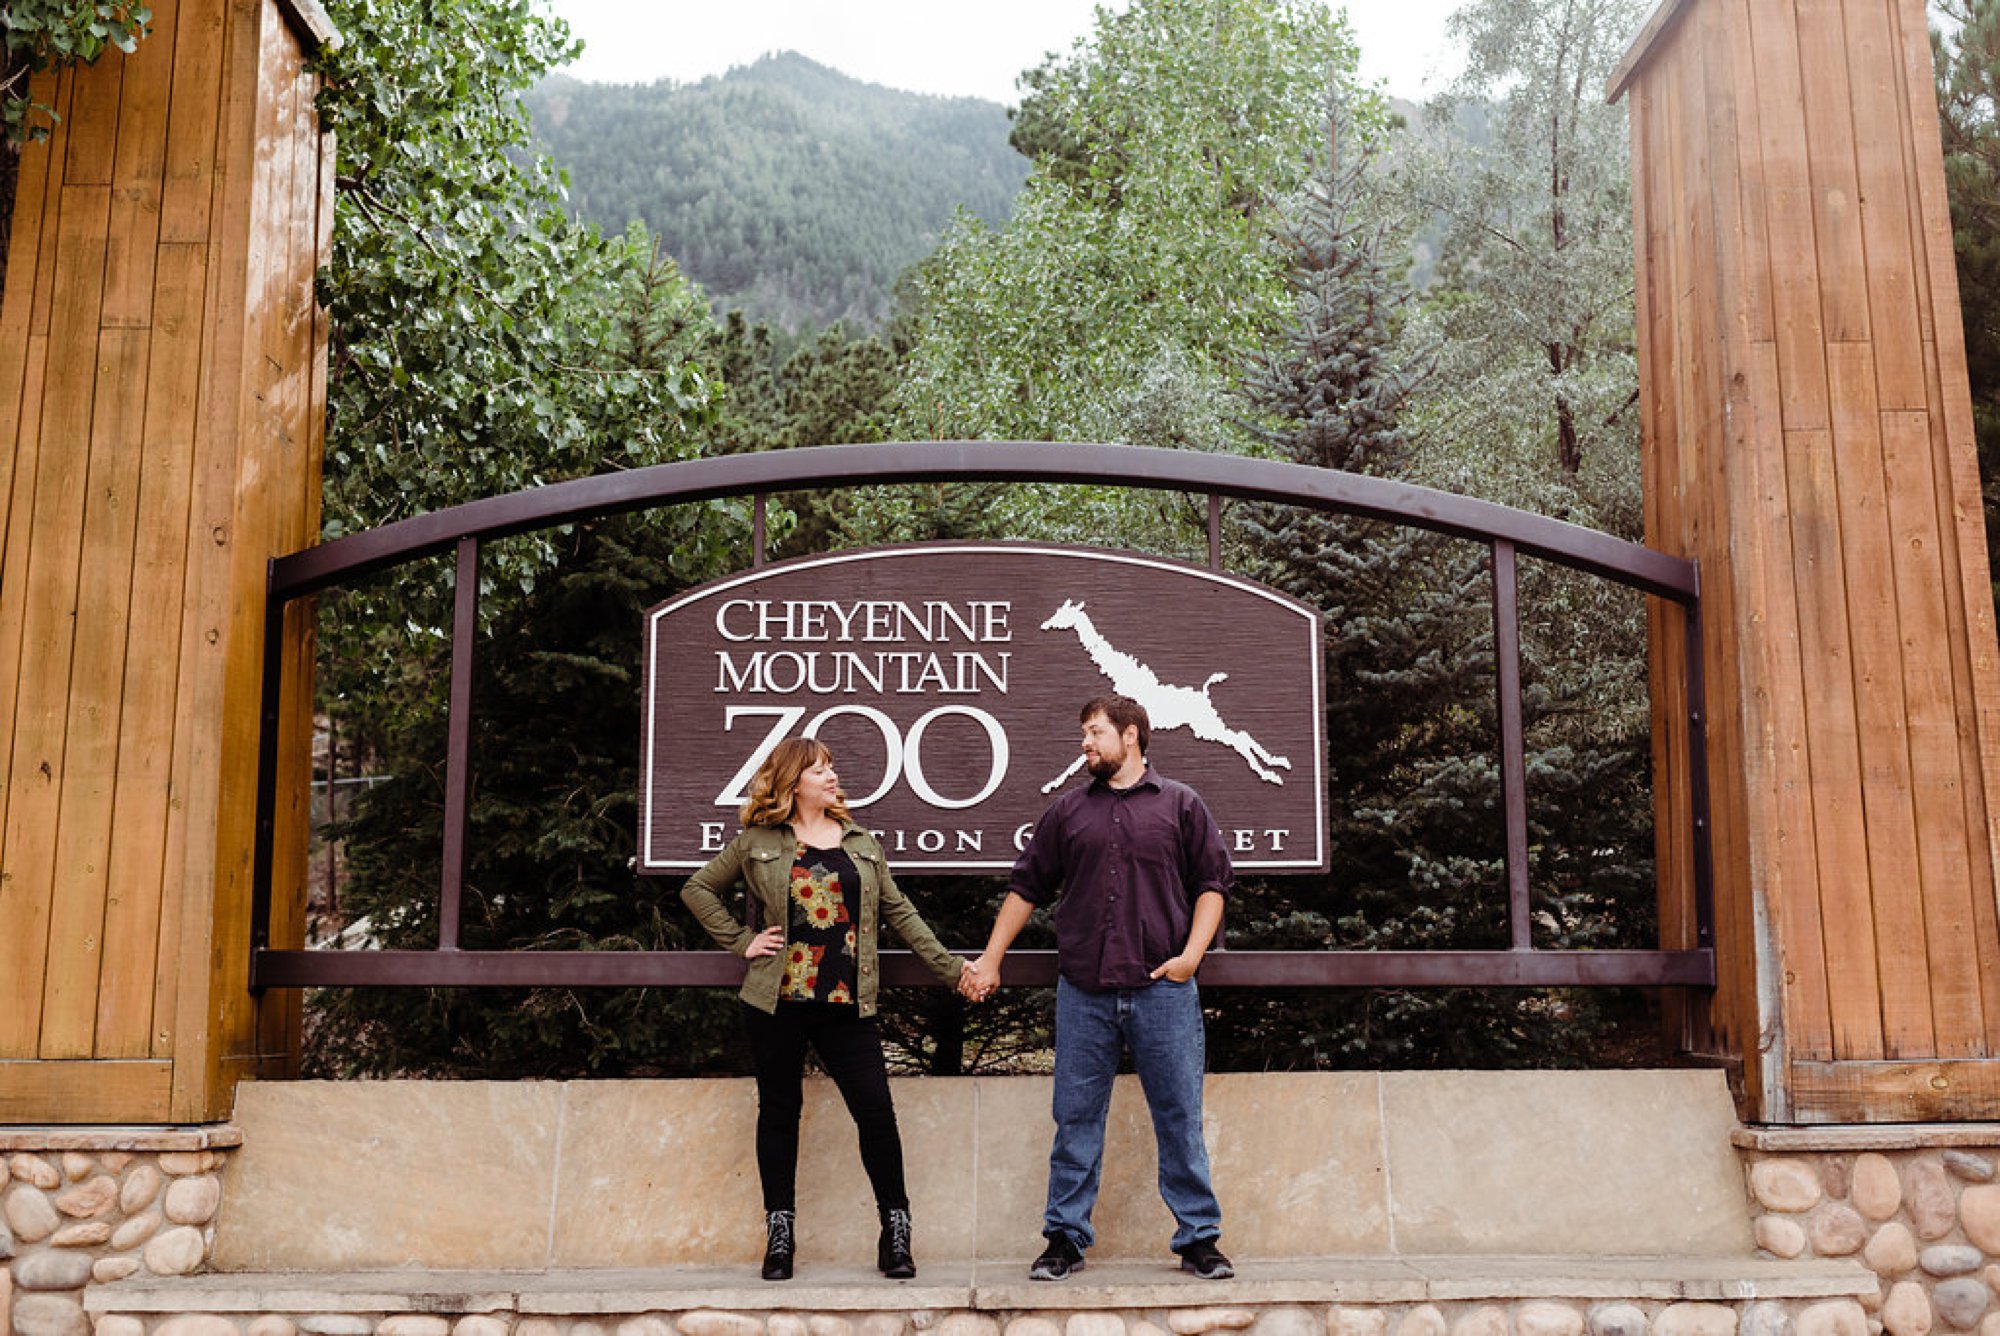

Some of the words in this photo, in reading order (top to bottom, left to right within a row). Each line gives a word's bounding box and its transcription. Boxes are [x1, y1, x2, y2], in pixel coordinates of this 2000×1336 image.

[716, 600, 1012, 642] CHEYENNE
[714, 651, 1012, 693] MOUNTAIN
[714, 704, 1009, 809] ZOO
[1218, 829, 1290, 851] ET
